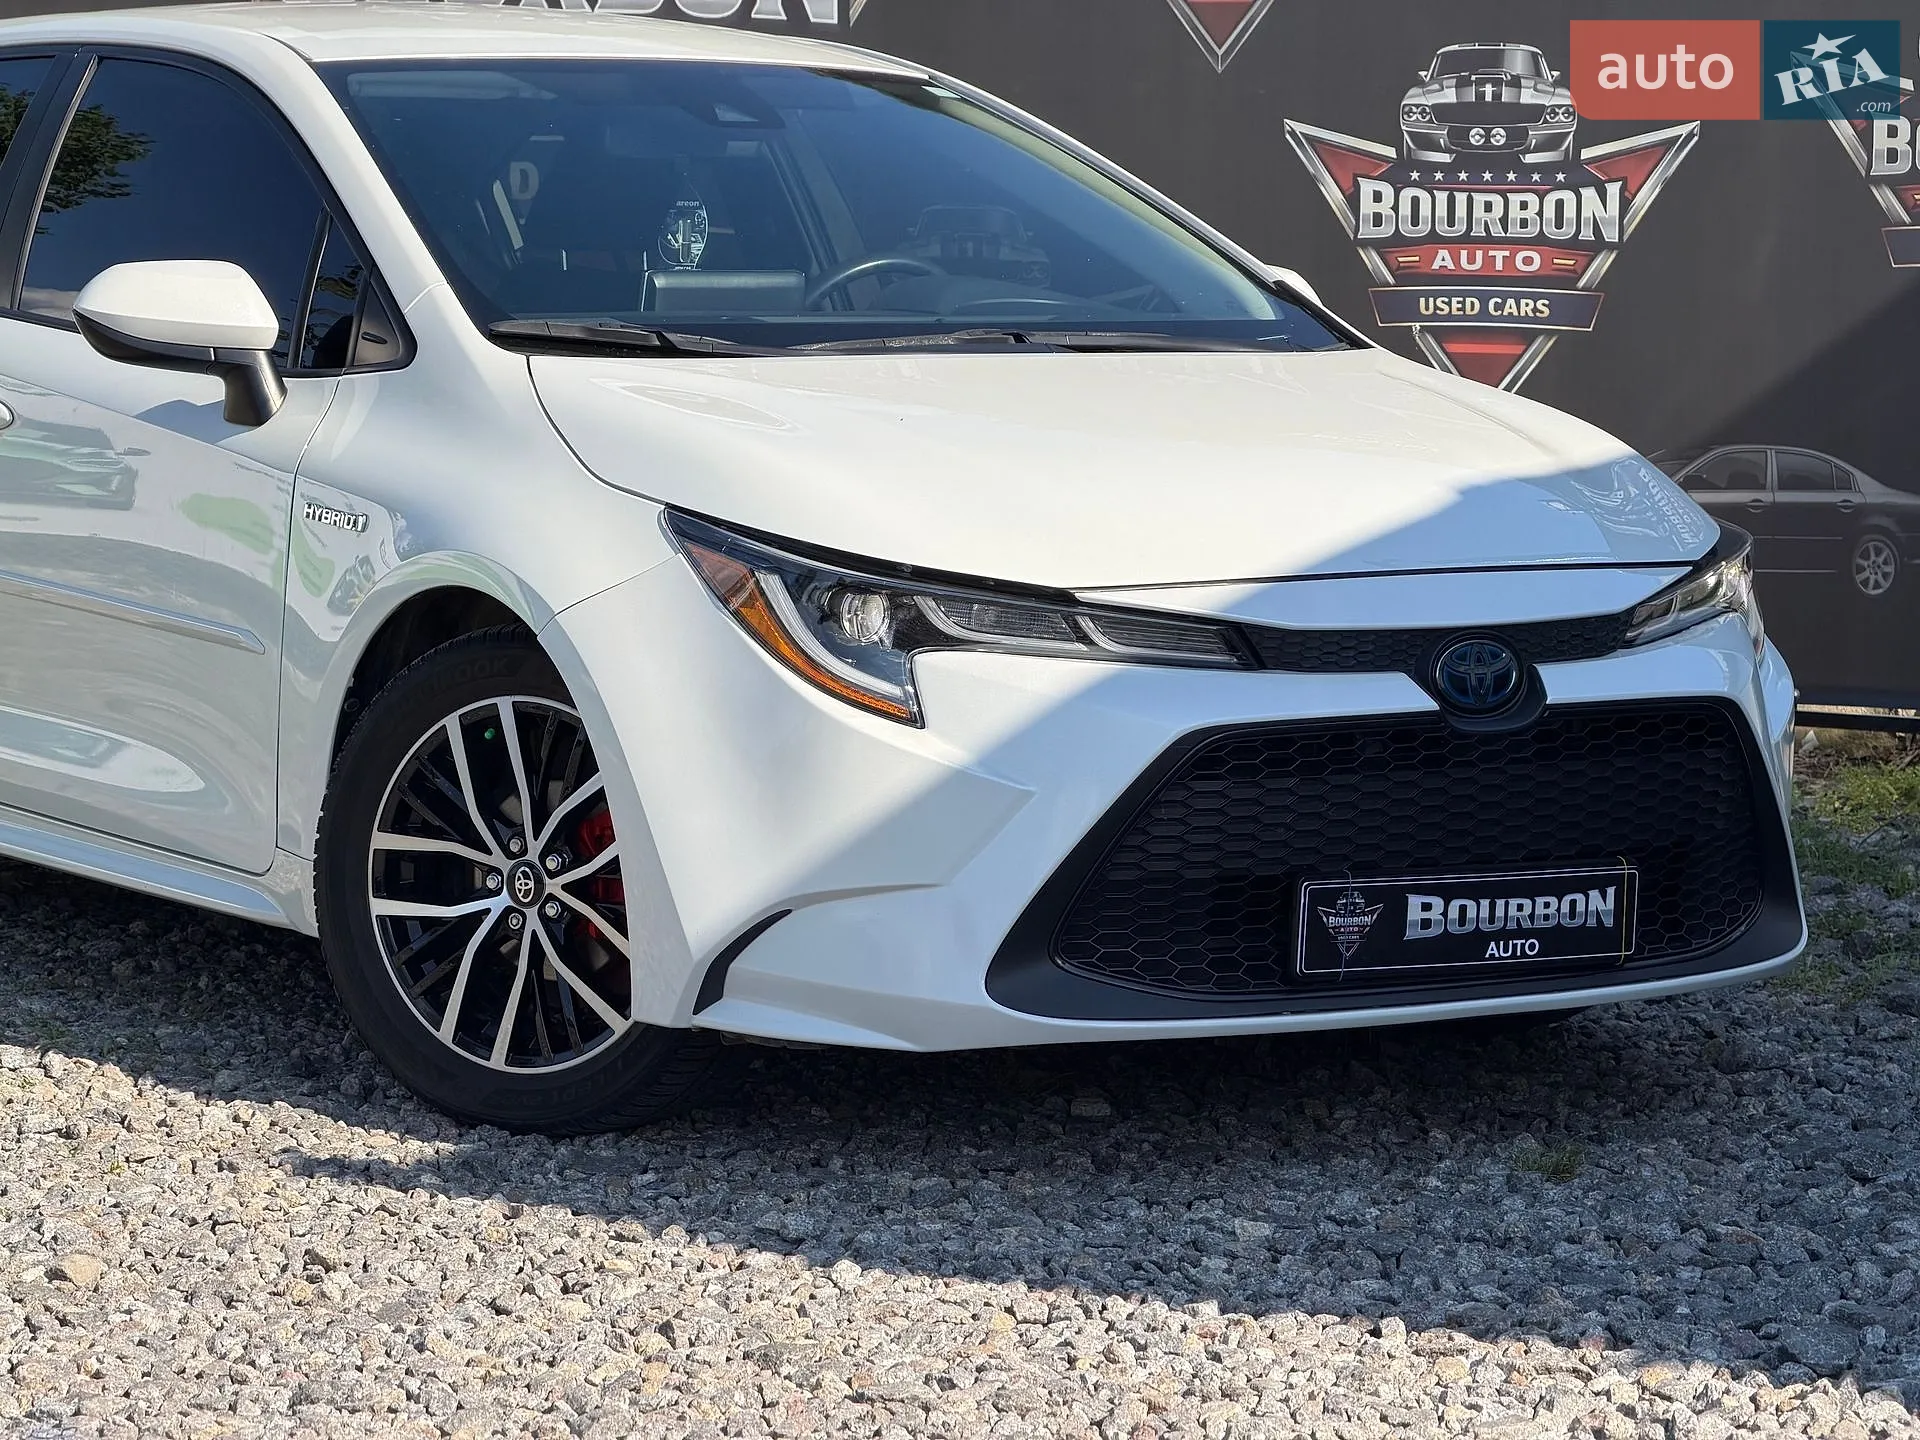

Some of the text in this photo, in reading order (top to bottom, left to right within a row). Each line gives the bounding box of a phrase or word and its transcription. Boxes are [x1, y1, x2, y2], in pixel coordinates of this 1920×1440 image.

[1357, 177, 1624, 244] BOURBON
[1431, 249, 1542, 272] AUTO
[1419, 296, 1551, 318] USED CARS
[1328, 914, 1371, 928] BOURBON
[1403, 886, 1617, 940] BOURBON
[1485, 938, 1540, 958] AUTO
